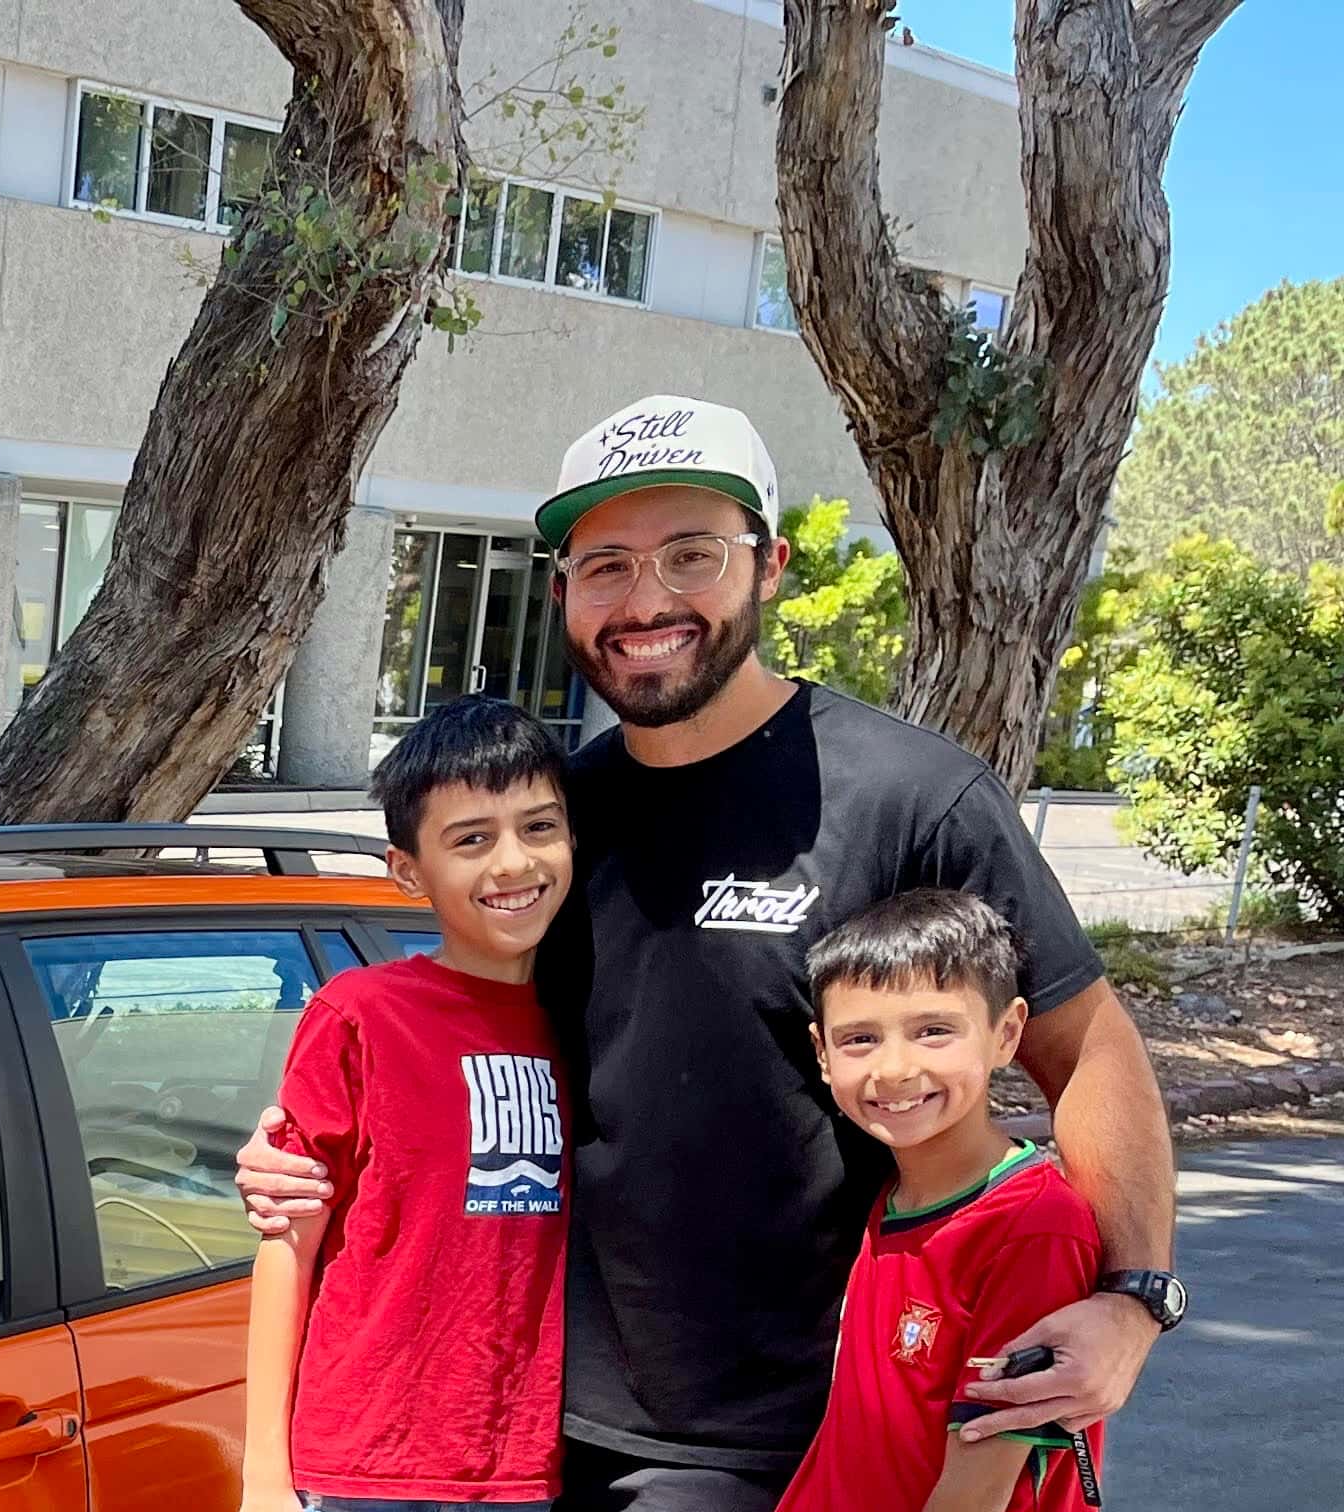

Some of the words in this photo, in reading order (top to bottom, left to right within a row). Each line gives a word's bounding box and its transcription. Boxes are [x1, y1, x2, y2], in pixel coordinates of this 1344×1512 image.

[612, 410, 694, 450] Still
[599, 443, 704, 480] Driven
[694, 872, 820, 928] Throtl
[465, 1200, 498, 1212] OFF
[501, 1200, 525, 1212] THE
[528, 1200, 560, 1212] WALL
[1074, 1432, 1096, 1498] RENDITION
